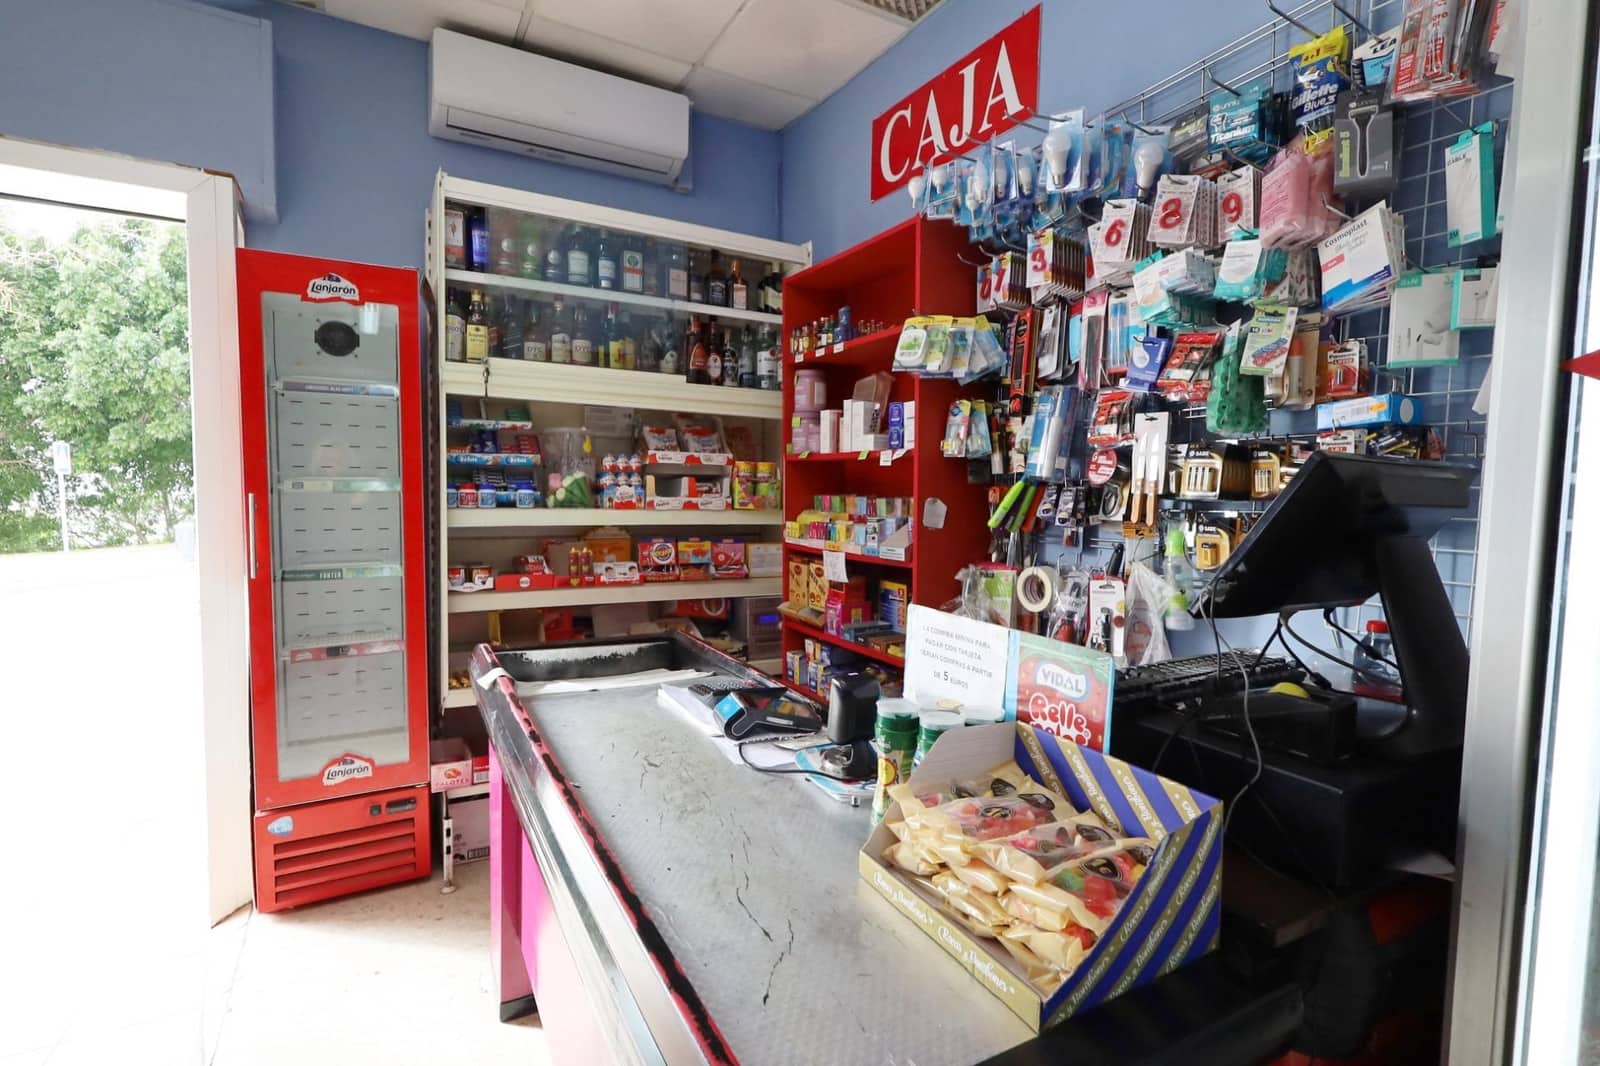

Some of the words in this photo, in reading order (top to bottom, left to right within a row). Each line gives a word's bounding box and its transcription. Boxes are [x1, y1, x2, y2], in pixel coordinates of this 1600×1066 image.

[1292, 83, 1338, 110] Gillette
[881, 40, 1024, 182] CAJA
[1159, 197, 1182, 230] 8
[1222, 192, 1243, 223] 9
[1105, 219, 1126, 247] 6
[1324, 218, 1368, 249] Cosmoplast
[1031, 247, 1047, 272] 3
[993, 268, 1006, 292] 1
[943, 671, 949, 681] 5
[1042, 668, 1083, 693] VIDAL
